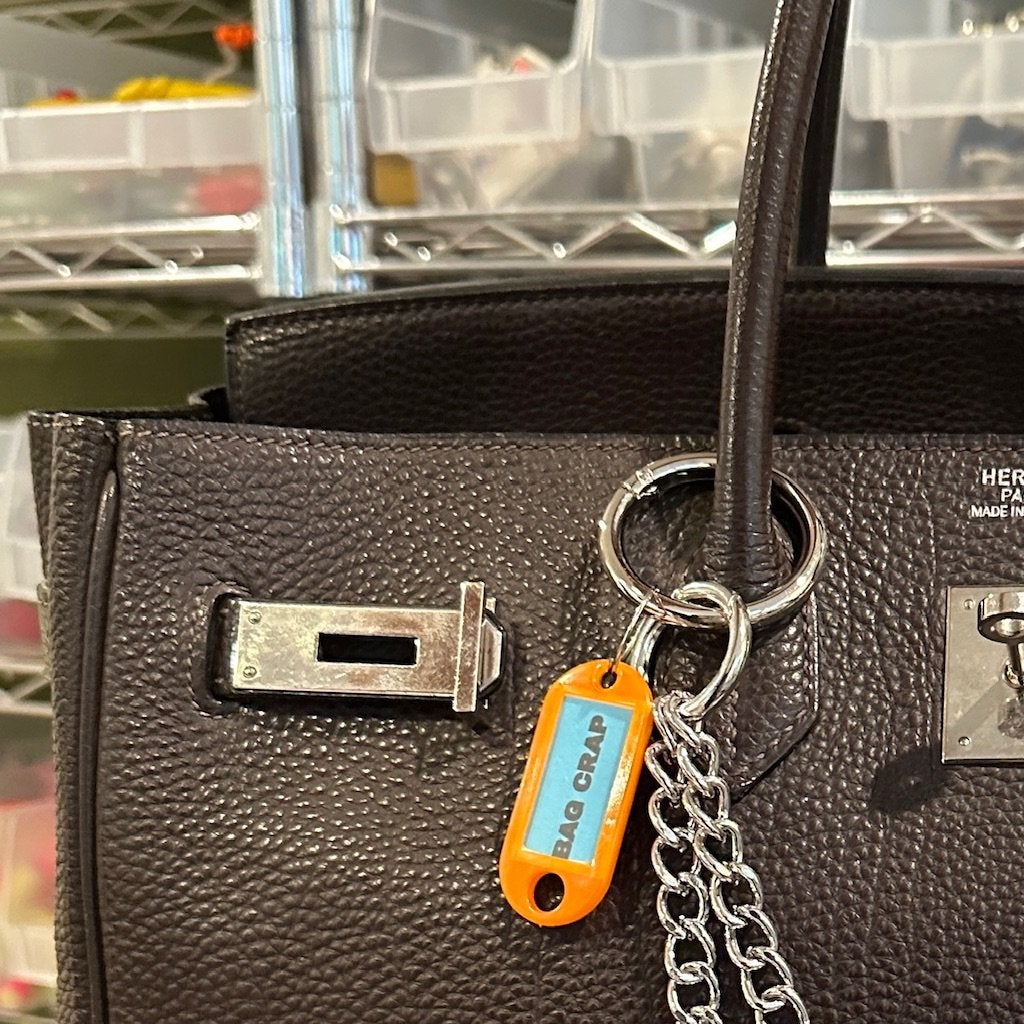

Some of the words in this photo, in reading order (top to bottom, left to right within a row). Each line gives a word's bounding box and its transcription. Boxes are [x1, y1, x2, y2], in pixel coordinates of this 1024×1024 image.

[971, 504, 1008, 518] MADE
[1010, 505, 1024, 518] IN
[551, 799, 585, 860] BAG
[572, 714, 608, 793] CRAP
